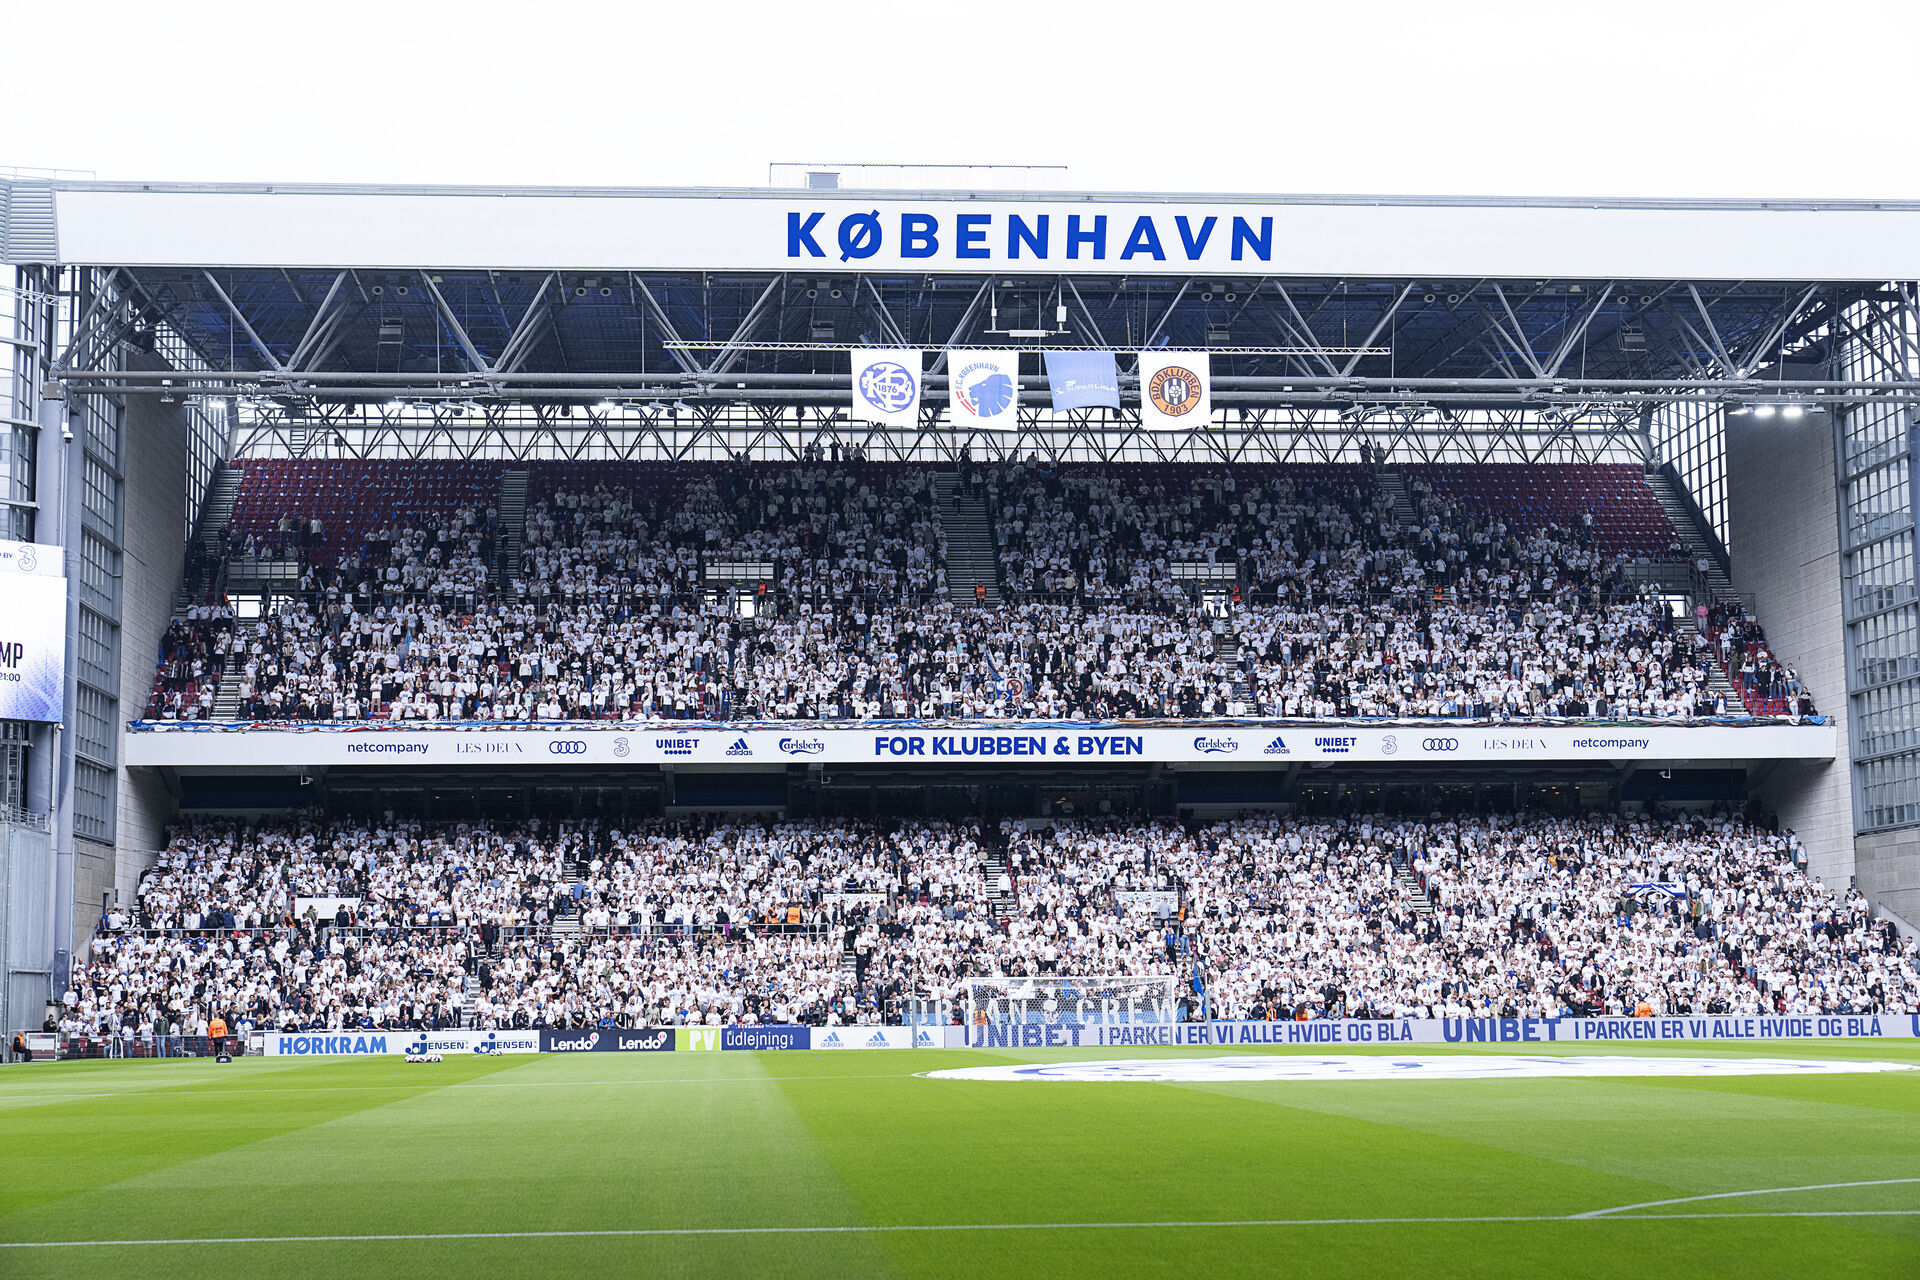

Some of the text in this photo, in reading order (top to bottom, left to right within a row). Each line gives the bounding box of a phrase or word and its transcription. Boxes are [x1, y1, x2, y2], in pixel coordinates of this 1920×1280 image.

[787, 209, 1274, 263] KØBENHAVN
[959, 362, 1000, 379] KØBENHAVN
[878, 384, 898, 394] 1876
[1152, 368, 1200, 401] BOLDKLUBBEN
[1164, 404, 1188, 415] 1903
[347, 741, 429, 754] netcompany
[456, 742, 523, 754] LES DEUX
[655, 739, 700, 749] UNIBET
[778, 738, 825, 755] Carlsberg
[875, 736, 1143, 756] FOR KLUBBEN & BYEN
[1193, 737, 1239, 754] Carlsberg
[1314, 737, 1358, 747] UNIBET
[1483, 739, 1547, 750] LES DEUX
[1572, 737, 1650, 750] netcompany
[725, 748, 753, 756] adidas
[1263, 747, 1291, 755] adidas
[1109, 1026, 1182, 1045] PARKEN
[1216, 1025, 1234, 1043] VI
[1239, 1025, 1283, 1043] ALLE
[1288, 1023, 1342, 1042] HVIDE
[1347, 1023, 1372, 1042] OG
[1377, 1019, 1413, 1041] BLÅ
[1443, 1018, 1561, 1042] UNIBET
[1585, 1020, 1657, 1039] PARKEN
[1662, 1020, 1684, 1039] ER
[1689, 1020, 1707, 1038] VI
[1712, 1019, 1754, 1038] ALLE
[1760, 1018, 1812, 1037] HVIDE
[1818, 1018, 1842, 1036] OG
[1847, 1015, 1882, 1036] BLÅ
[964, 1023, 1085, 1048] UNIBET
[279, 1036, 387, 1055] HØRKRAM
[550, 1037, 594, 1051] Lendo
[618, 1036, 661, 1050] Lendo
[865, 1040, 890, 1048] adidas
